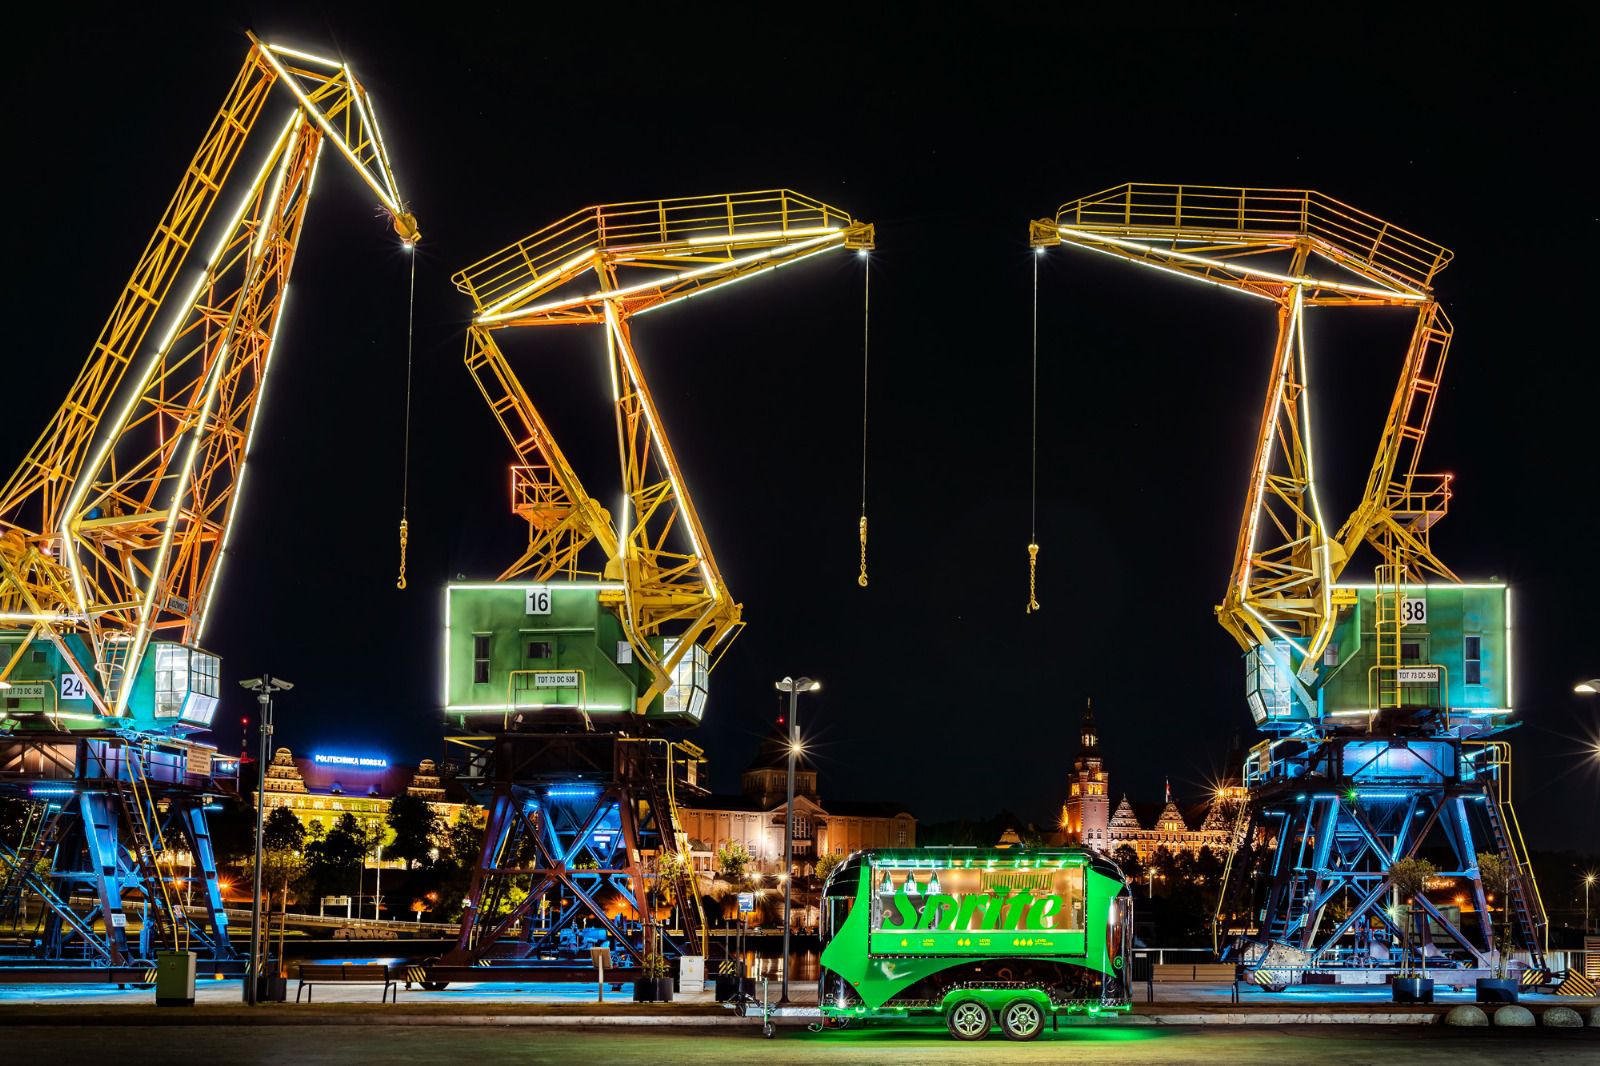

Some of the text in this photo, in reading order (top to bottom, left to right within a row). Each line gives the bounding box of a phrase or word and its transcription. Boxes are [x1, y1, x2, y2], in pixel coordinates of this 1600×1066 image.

[529, 593, 549, 611] 16
[1402, 601, 1424, 621] 38
[62, 677, 84, 697] 24
[315, 754, 387, 767] POLITECHNIKA MORSKA
[880, 881, 1064, 930] Sprite
